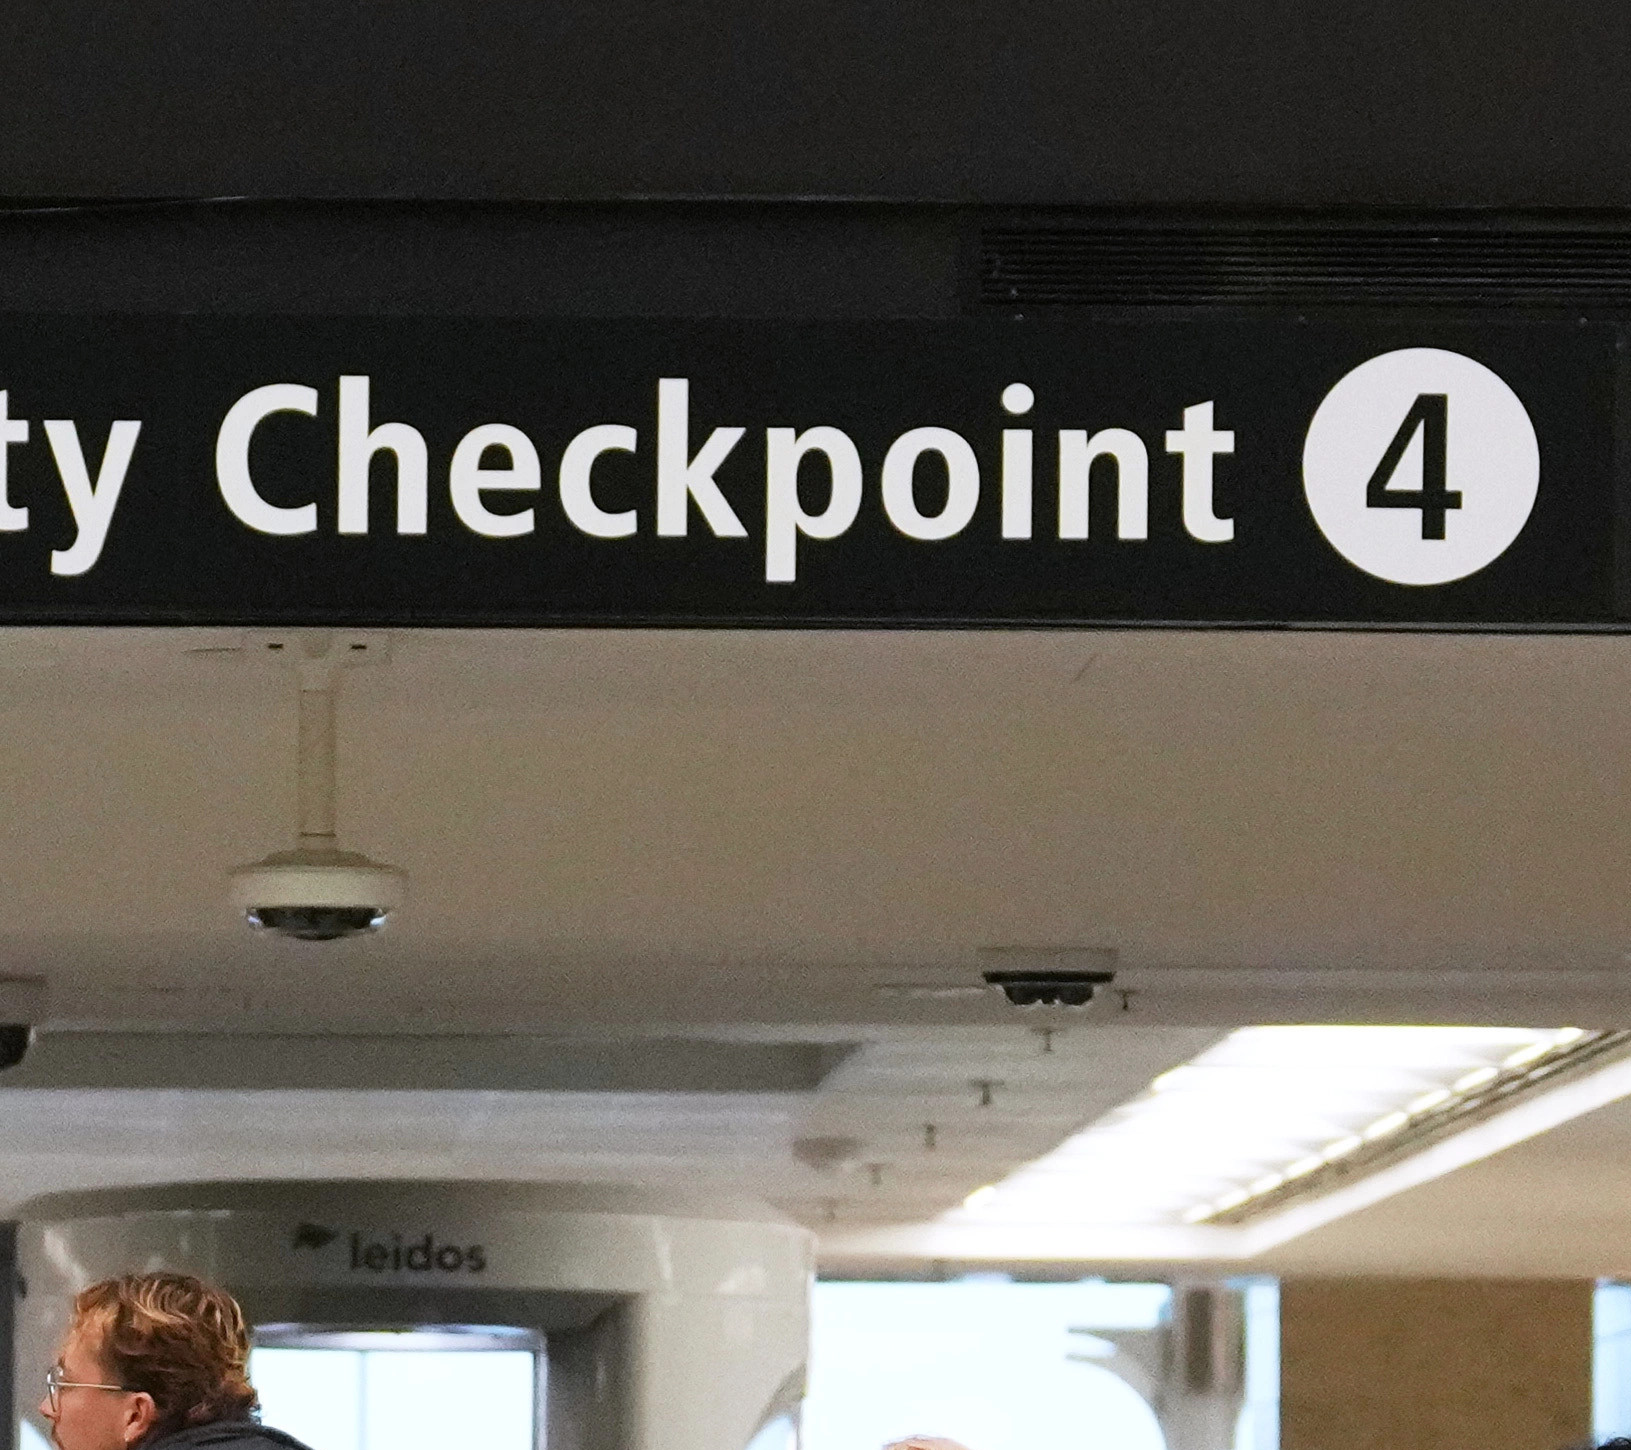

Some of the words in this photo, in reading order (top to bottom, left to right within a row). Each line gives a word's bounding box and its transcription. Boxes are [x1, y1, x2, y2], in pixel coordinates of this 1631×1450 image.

[214, 376, 1236, 583] Checkpoint
[1364, 392, 1465, 541] 4
[350, 1233, 486, 1272] leidos
